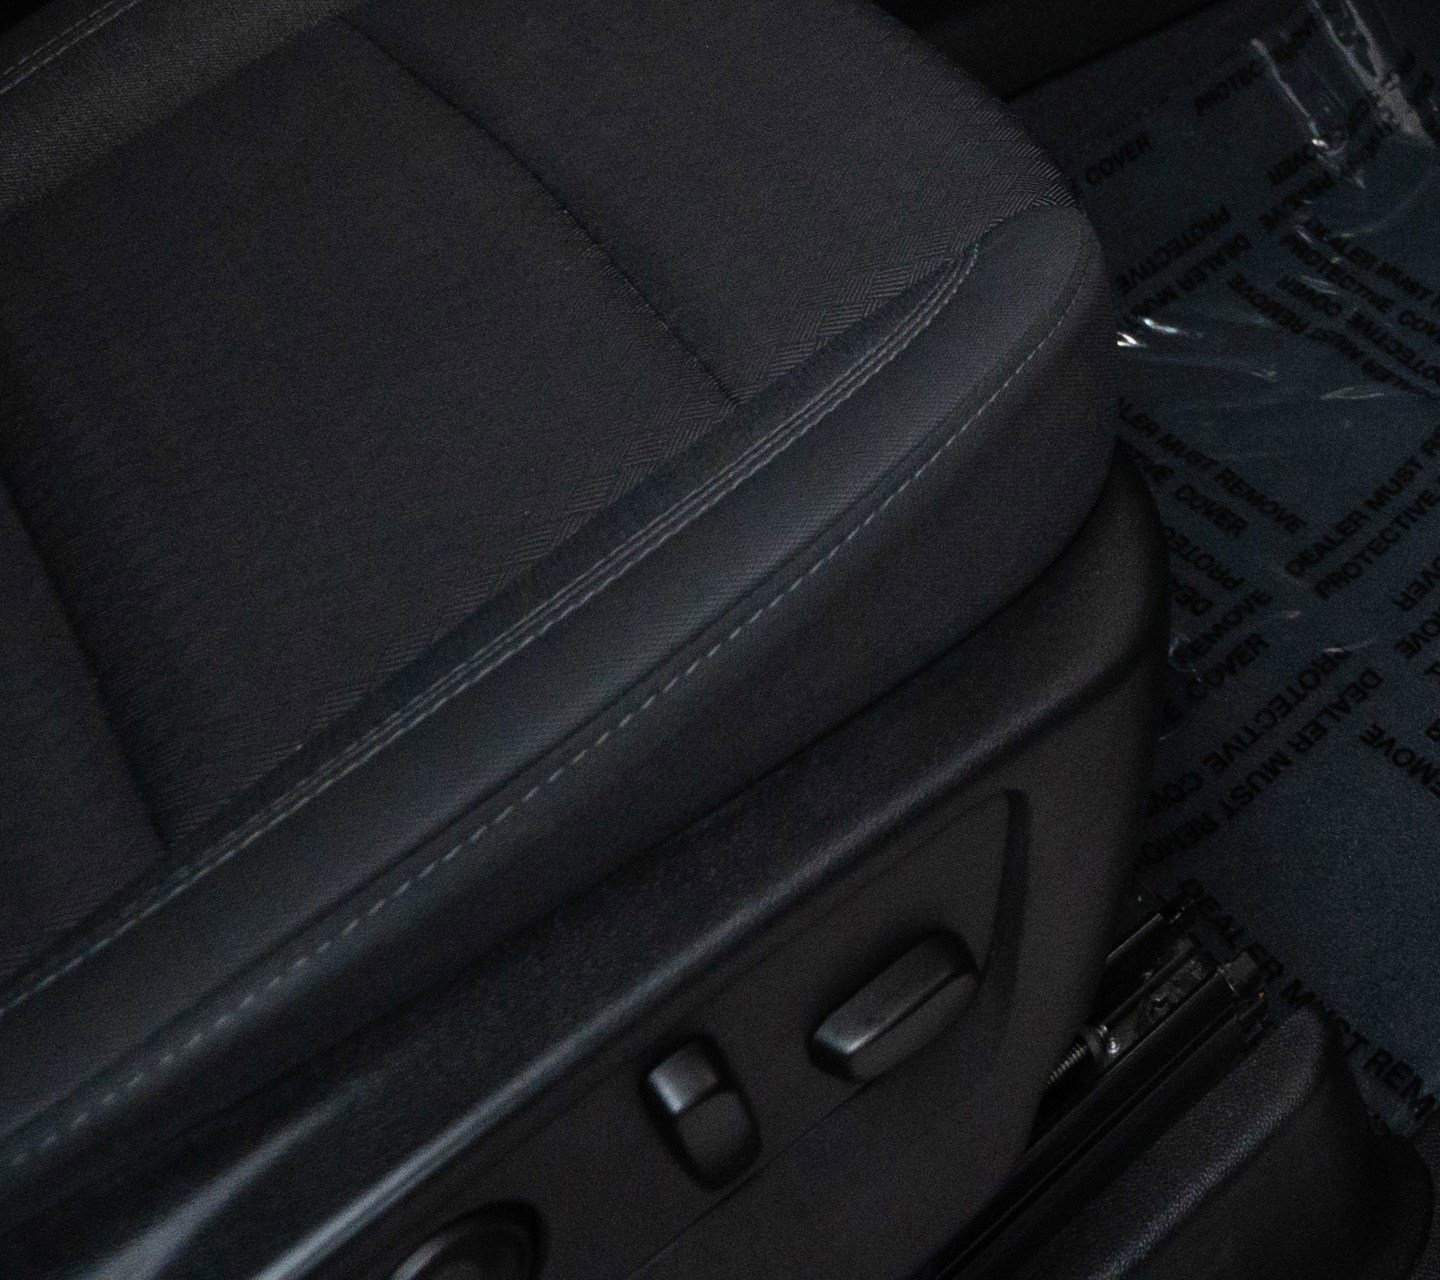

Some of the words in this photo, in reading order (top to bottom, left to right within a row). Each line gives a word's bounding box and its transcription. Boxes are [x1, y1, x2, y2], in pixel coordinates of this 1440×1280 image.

[1080, 129, 1157, 188] COVER
[1111, 203, 1234, 296] PROTECTIVE
[1172, 230, 1253, 294] DEALER
[1277, 228, 1396, 316] PROTECTIVE
[1375, 258, 1435, 305] MUST
[1226, 270, 1310, 338] REMOVE
[1273, 270, 1345, 321] COVER
[1154, 427, 1222, 478] MUST
[1212, 463, 1308, 538] REMOVE
[1172, 480, 1249, 539] COVER
[1281, 504, 1370, 581] DEALER
[1363, 453, 1425, 515] MUST
[1181, 629, 1271, 705] COVER
[1286, 665, 1384, 756] DEALER
[1213, 748, 1294, 820] MUST
